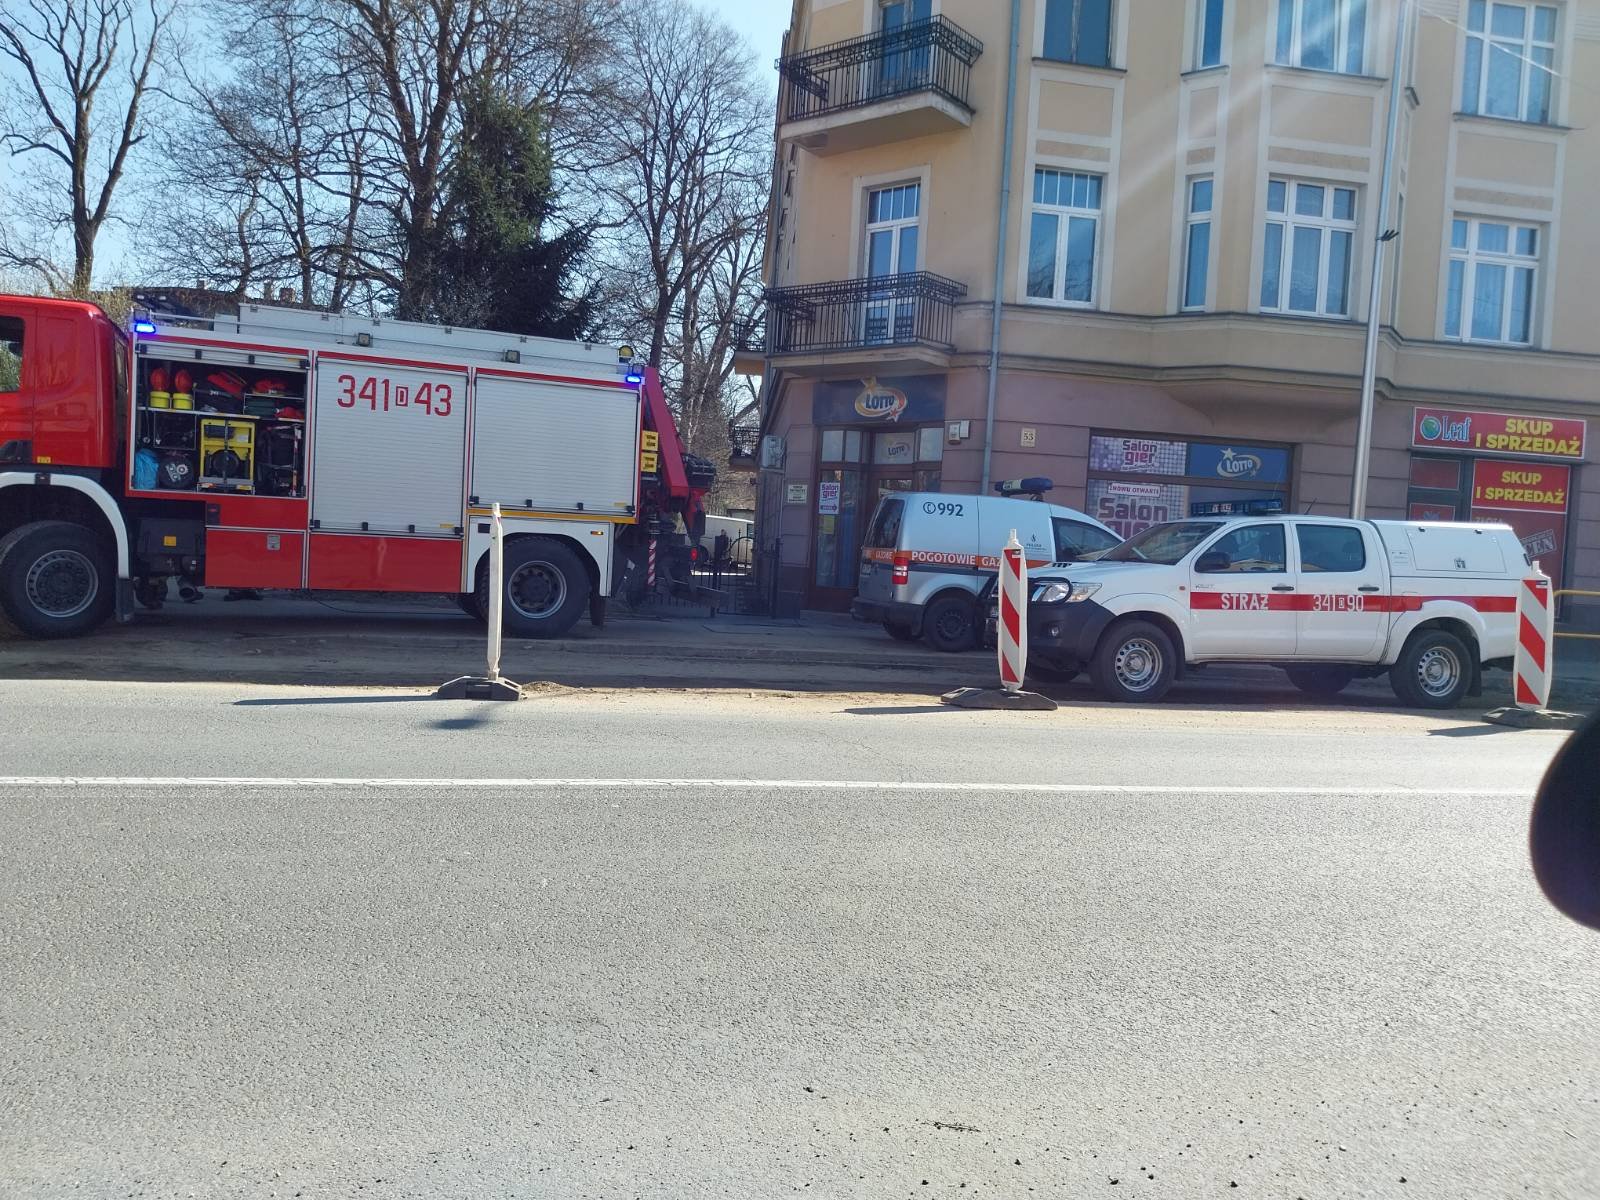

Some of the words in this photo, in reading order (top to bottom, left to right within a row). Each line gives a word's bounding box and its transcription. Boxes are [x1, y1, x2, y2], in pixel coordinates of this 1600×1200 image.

[337, 374, 390, 412] 341
[414, 382, 452, 417] 43
[865, 394, 895, 409] LOTTO
[1441, 416, 1472, 443] Leaf
[1505, 418, 1553, 436] SKUP
[1023, 431, 1034, 441] 53
[1475, 433, 1481, 448] I
[1486, 433, 1580, 455] SPRZEDAŻ
[1122, 439, 1157, 453] Salon
[1124, 451, 1155, 466] gier
[1226, 459, 1253, 472] LOTTO
[1502, 470, 1542, 485] SKUP
[1475, 487, 1480, 499] I
[1485, 487, 1565, 504] SPRZEDAŻ
[937, 502, 964, 517] 992
[1098, 497, 1168, 522] Salon
[911, 550, 976, 566] POGOTOWIE
[1312, 595, 1336, 612] 341
[1347, 595, 1364, 612] 90
